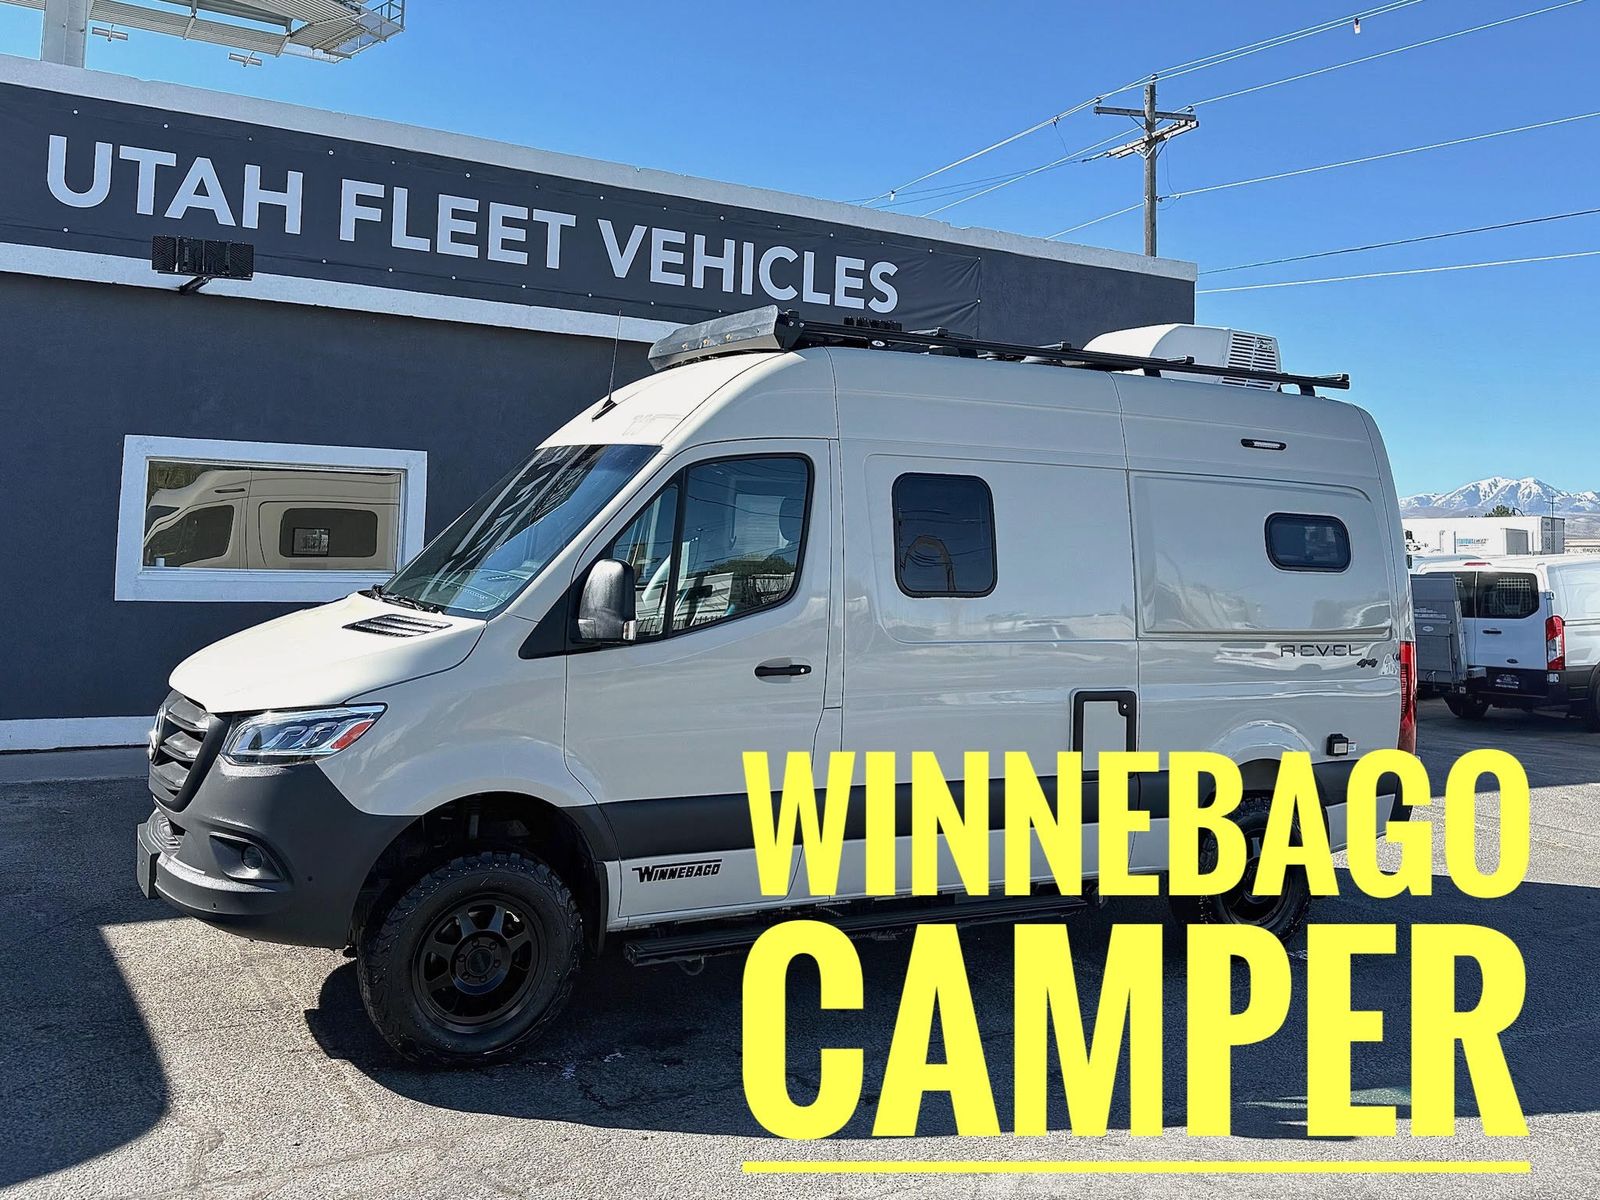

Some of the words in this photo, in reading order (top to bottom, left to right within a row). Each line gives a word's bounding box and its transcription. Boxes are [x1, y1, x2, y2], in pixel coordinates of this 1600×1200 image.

[47, 134, 304, 236] UTAH
[339, 178, 577, 270] FLEET
[597, 218, 899, 314] VEHICLES
[1280, 644, 1362, 657] REVEL
